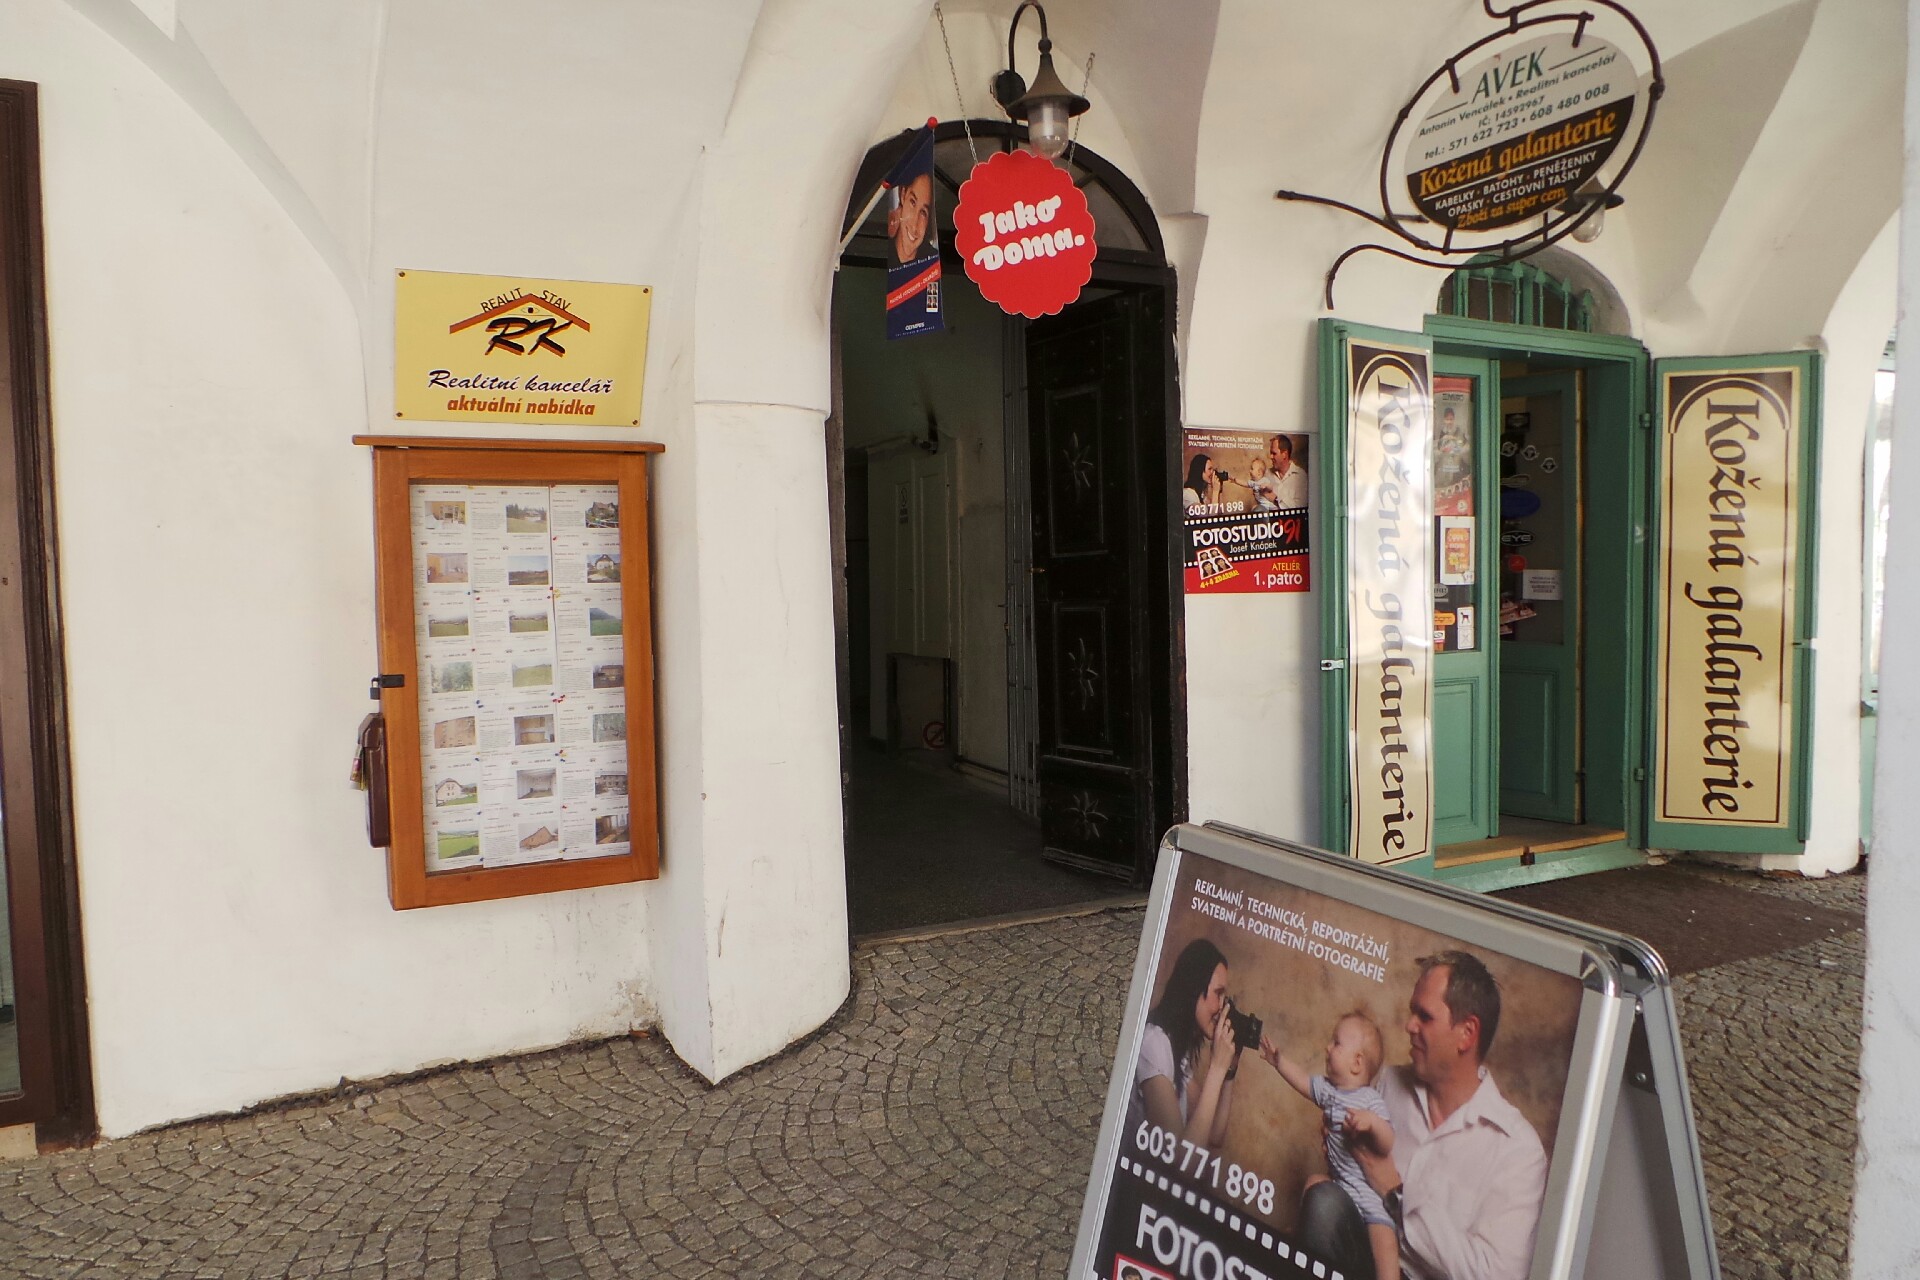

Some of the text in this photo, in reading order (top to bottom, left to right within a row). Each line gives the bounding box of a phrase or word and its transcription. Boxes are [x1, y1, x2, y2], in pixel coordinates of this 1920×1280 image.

[1471, 46, 1547, 104] AVEK
[1425, 83, 1610, 160] tel.: 571 622 723 608 480 008
[1419, 109, 1617, 197] Kožená galanterie
[1435, 151, 1597, 211] KABELKY BATOHY PENĚŽENKY
[1492, 177, 1545, 204] CESTOVNÍ
[1548, 168, 1582, 189] TAŠKY
[978, 195, 1062, 243] Jako
[973, 228, 1086, 271] Doma.
[480, 287, 524, 312] REALIT
[540, 289, 572, 311] STAV
[485, 317, 573, 357] RK
[427, 369, 614, 394] Realitní kancelář
[447, 395, 596, 416] aktuální nabídka
[1188, 501, 1244, 516] 603 771 898
[1192, 521, 1283, 547] FOTOSTUDIO
[1229, 543, 1248, 554] Josef
[1253, 571, 1303, 588] 1. patro
[1272, 559, 1301, 571] ATELIÉR
[1364, 373, 1415, 857] Kožená galanterie
[1684, 398, 1763, 815] Kožená galanterie
[1190, 896, 1386, 984] SVATEBNÍ A PORTRÉTNÍ FOTOGRAFIE
[1194, 878, 1391, 964] REKLAMNÍ, TECHNICKÁ, REPORTÁŽNÍ,
[1136, 1119, 1275, 1215] 603 771 898
